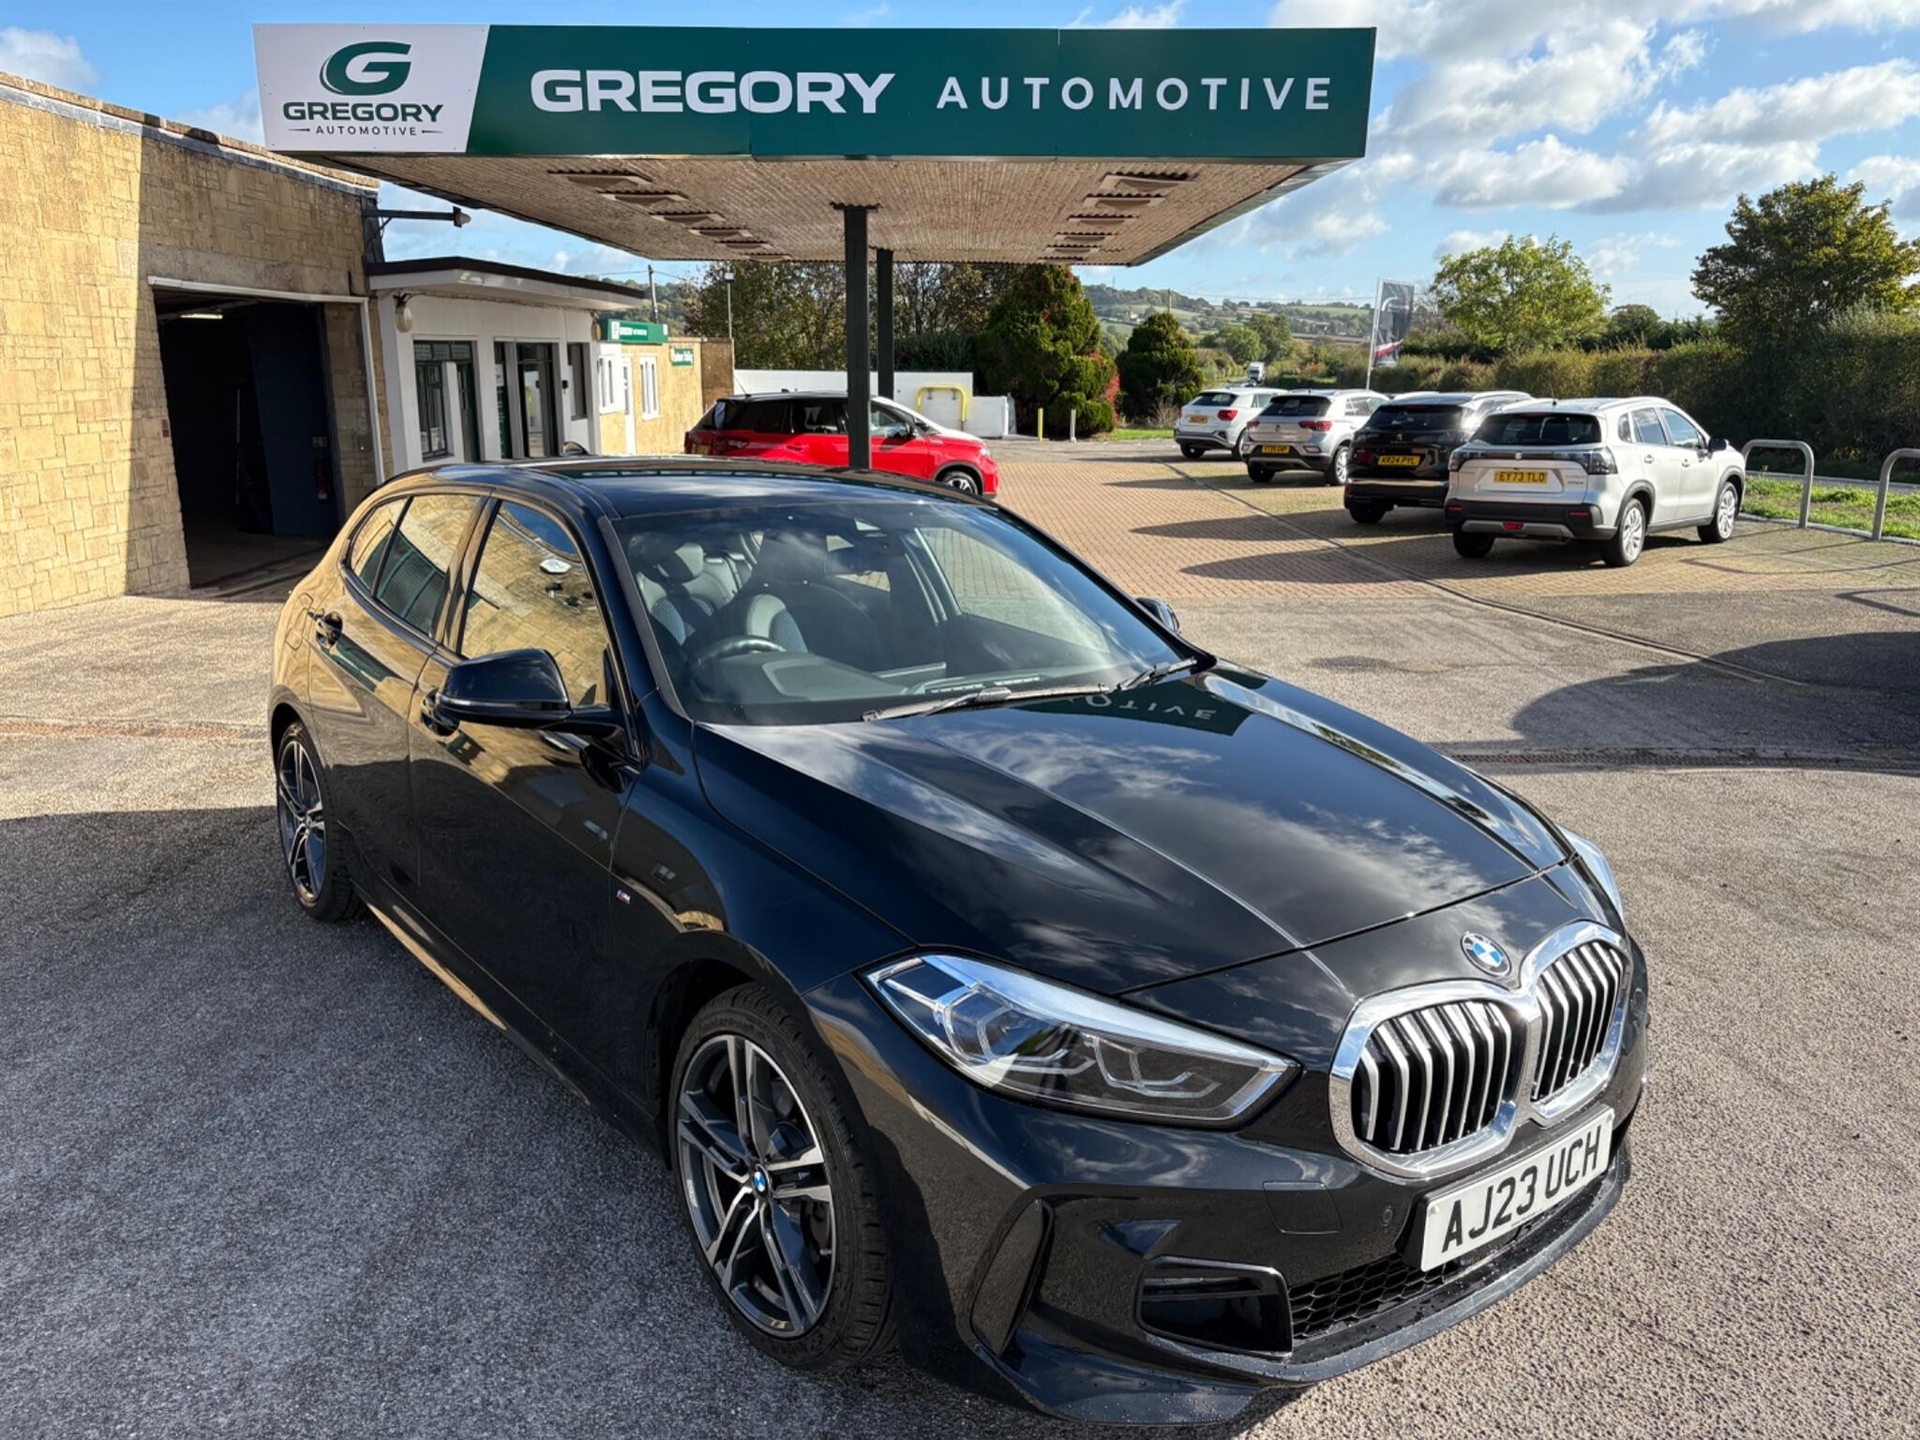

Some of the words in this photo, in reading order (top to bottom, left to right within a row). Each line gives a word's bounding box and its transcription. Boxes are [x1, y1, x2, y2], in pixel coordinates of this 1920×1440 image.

[319, 41, 411, 95] G
[530, 69, 896, 113] GREGORY
[936, 76, 1331, 111] AUTOMOTIVE
[283, 102, 444, 122] GREGORY
[315, 125, 417, 136] AUTOMOTIVE
[1499, 471, 1524, 482] EY73
[1441, 1164, 1538, 1253] AJ23
[1544, 1124, 1602, 1200] UCH
